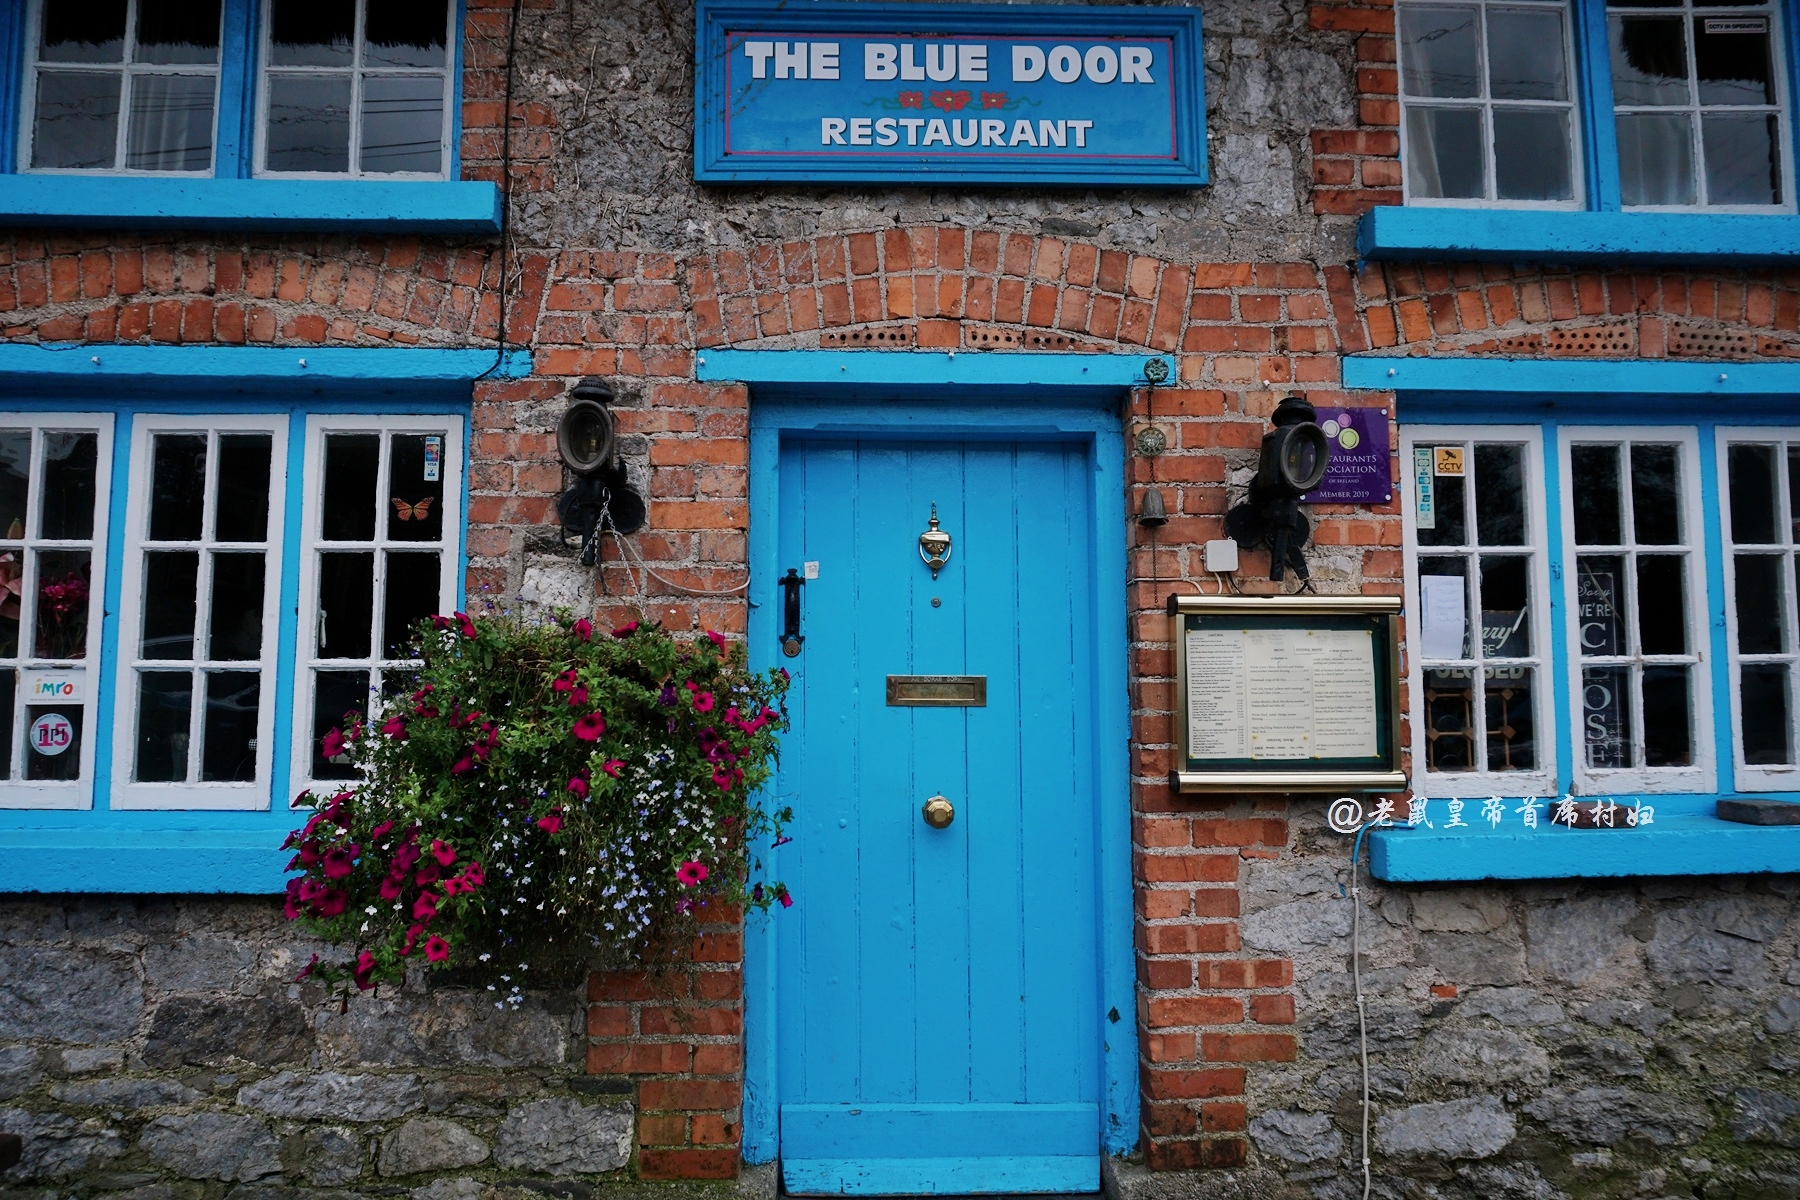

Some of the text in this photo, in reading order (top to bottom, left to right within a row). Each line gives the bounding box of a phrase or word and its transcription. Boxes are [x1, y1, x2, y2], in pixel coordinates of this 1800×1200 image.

[744, 41, 1156, 84] THE BLUE DOOR
[821, 117, 1093, 148] RESTAURANT
[1438, 462, 1462, 470] CCTV
[1352, 490, 1370, 498] 2019
[35, 678, 74, 697] imro
